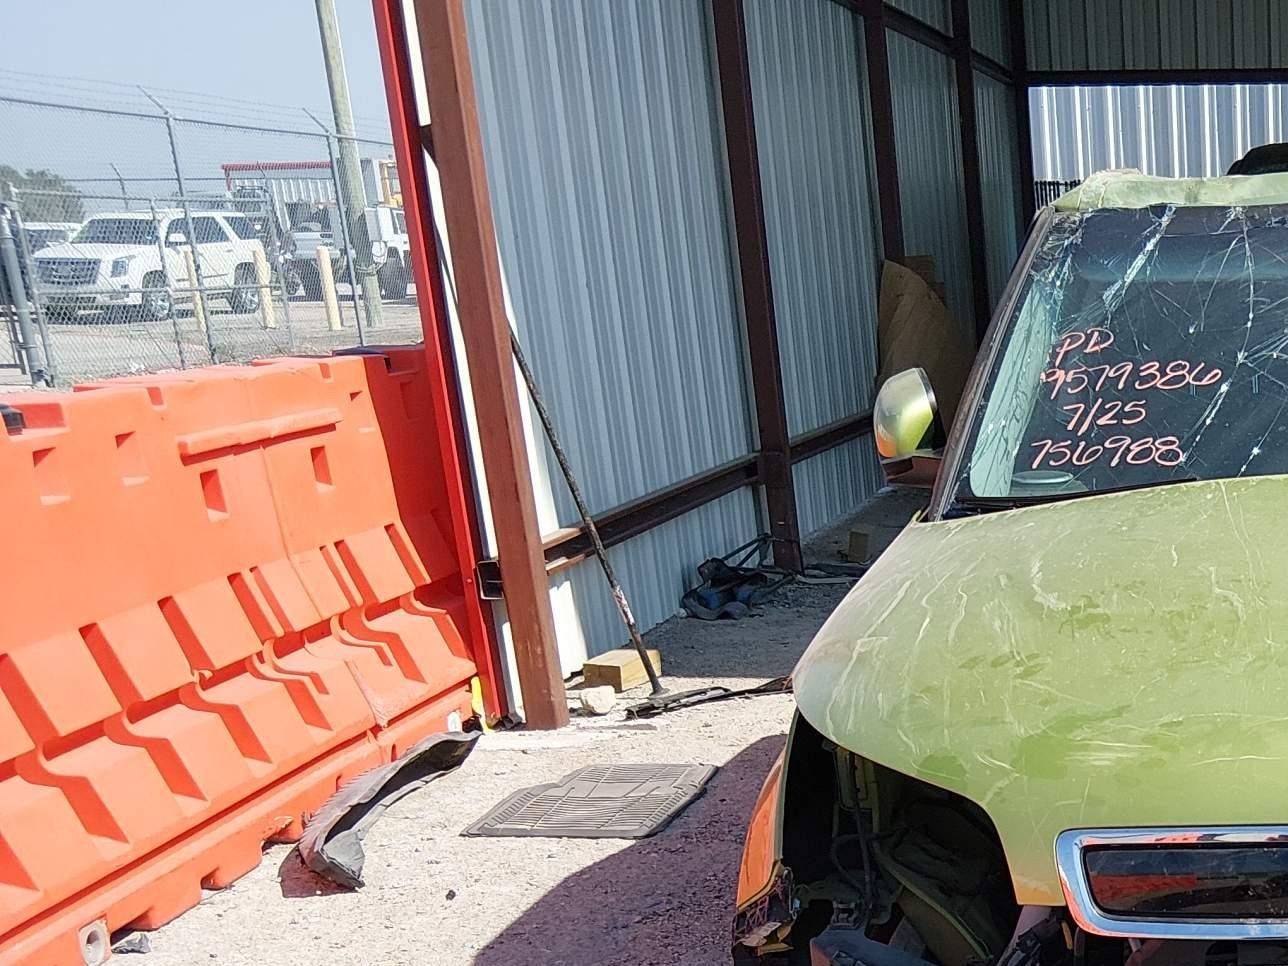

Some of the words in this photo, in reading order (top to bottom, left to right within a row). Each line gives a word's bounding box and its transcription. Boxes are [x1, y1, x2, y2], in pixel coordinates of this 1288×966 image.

[1054, 327, 1115, 367] PD
[1039, 360, 1223, 400] 9579386
[1063, 398, 1147, 436] 7/25
[1030, 435, 1184, 470] 756988
